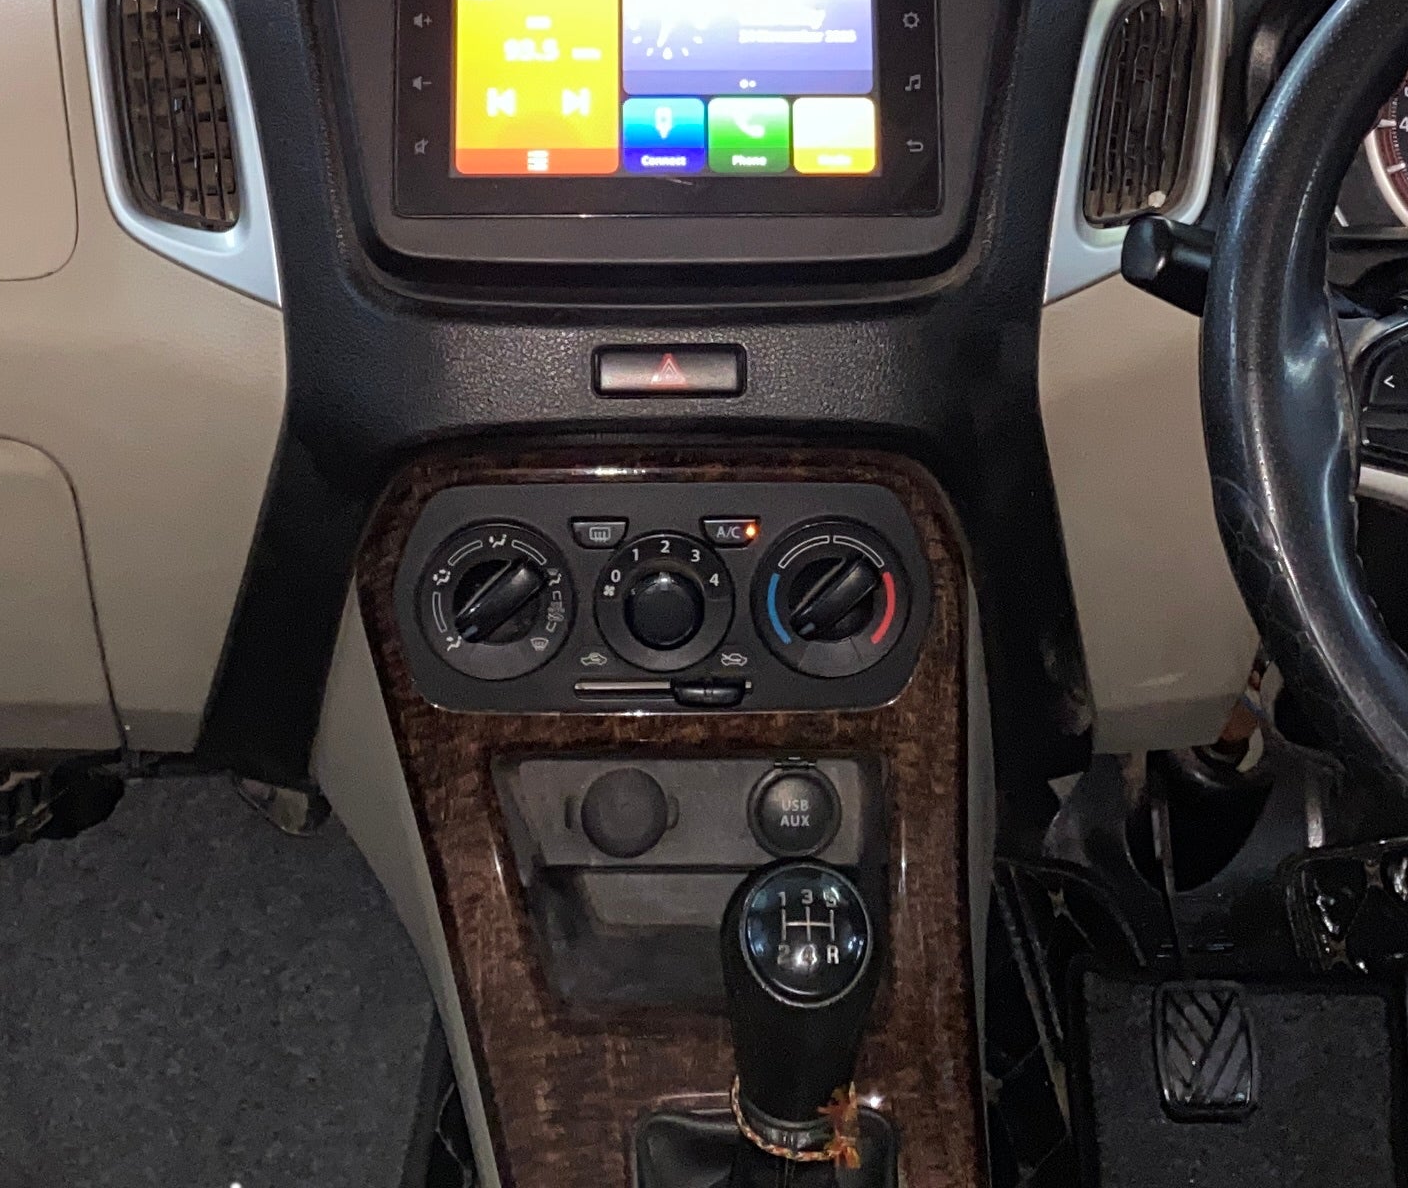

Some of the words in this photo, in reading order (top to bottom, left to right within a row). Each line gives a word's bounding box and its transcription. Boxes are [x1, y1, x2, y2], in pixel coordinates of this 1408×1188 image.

[732, 154, 767, 166] Phone
[716, 526, 741, 539] A/C
[660, 540, 670, 553] 2
[632, 549, 639, 561] 1
[691, 549, 701, 562] 3
[610, 569, 621, 582] 0
[709, 573, 719, 586] 4
[781, 799, 809, 812] USB
[780, 815, 810, 827] AUX
[778, 891, 786, 906] 1
[801, 889, 813, 904] 3
[777, 944, 790, 965] 2
[826, 944, 839, 964] R
